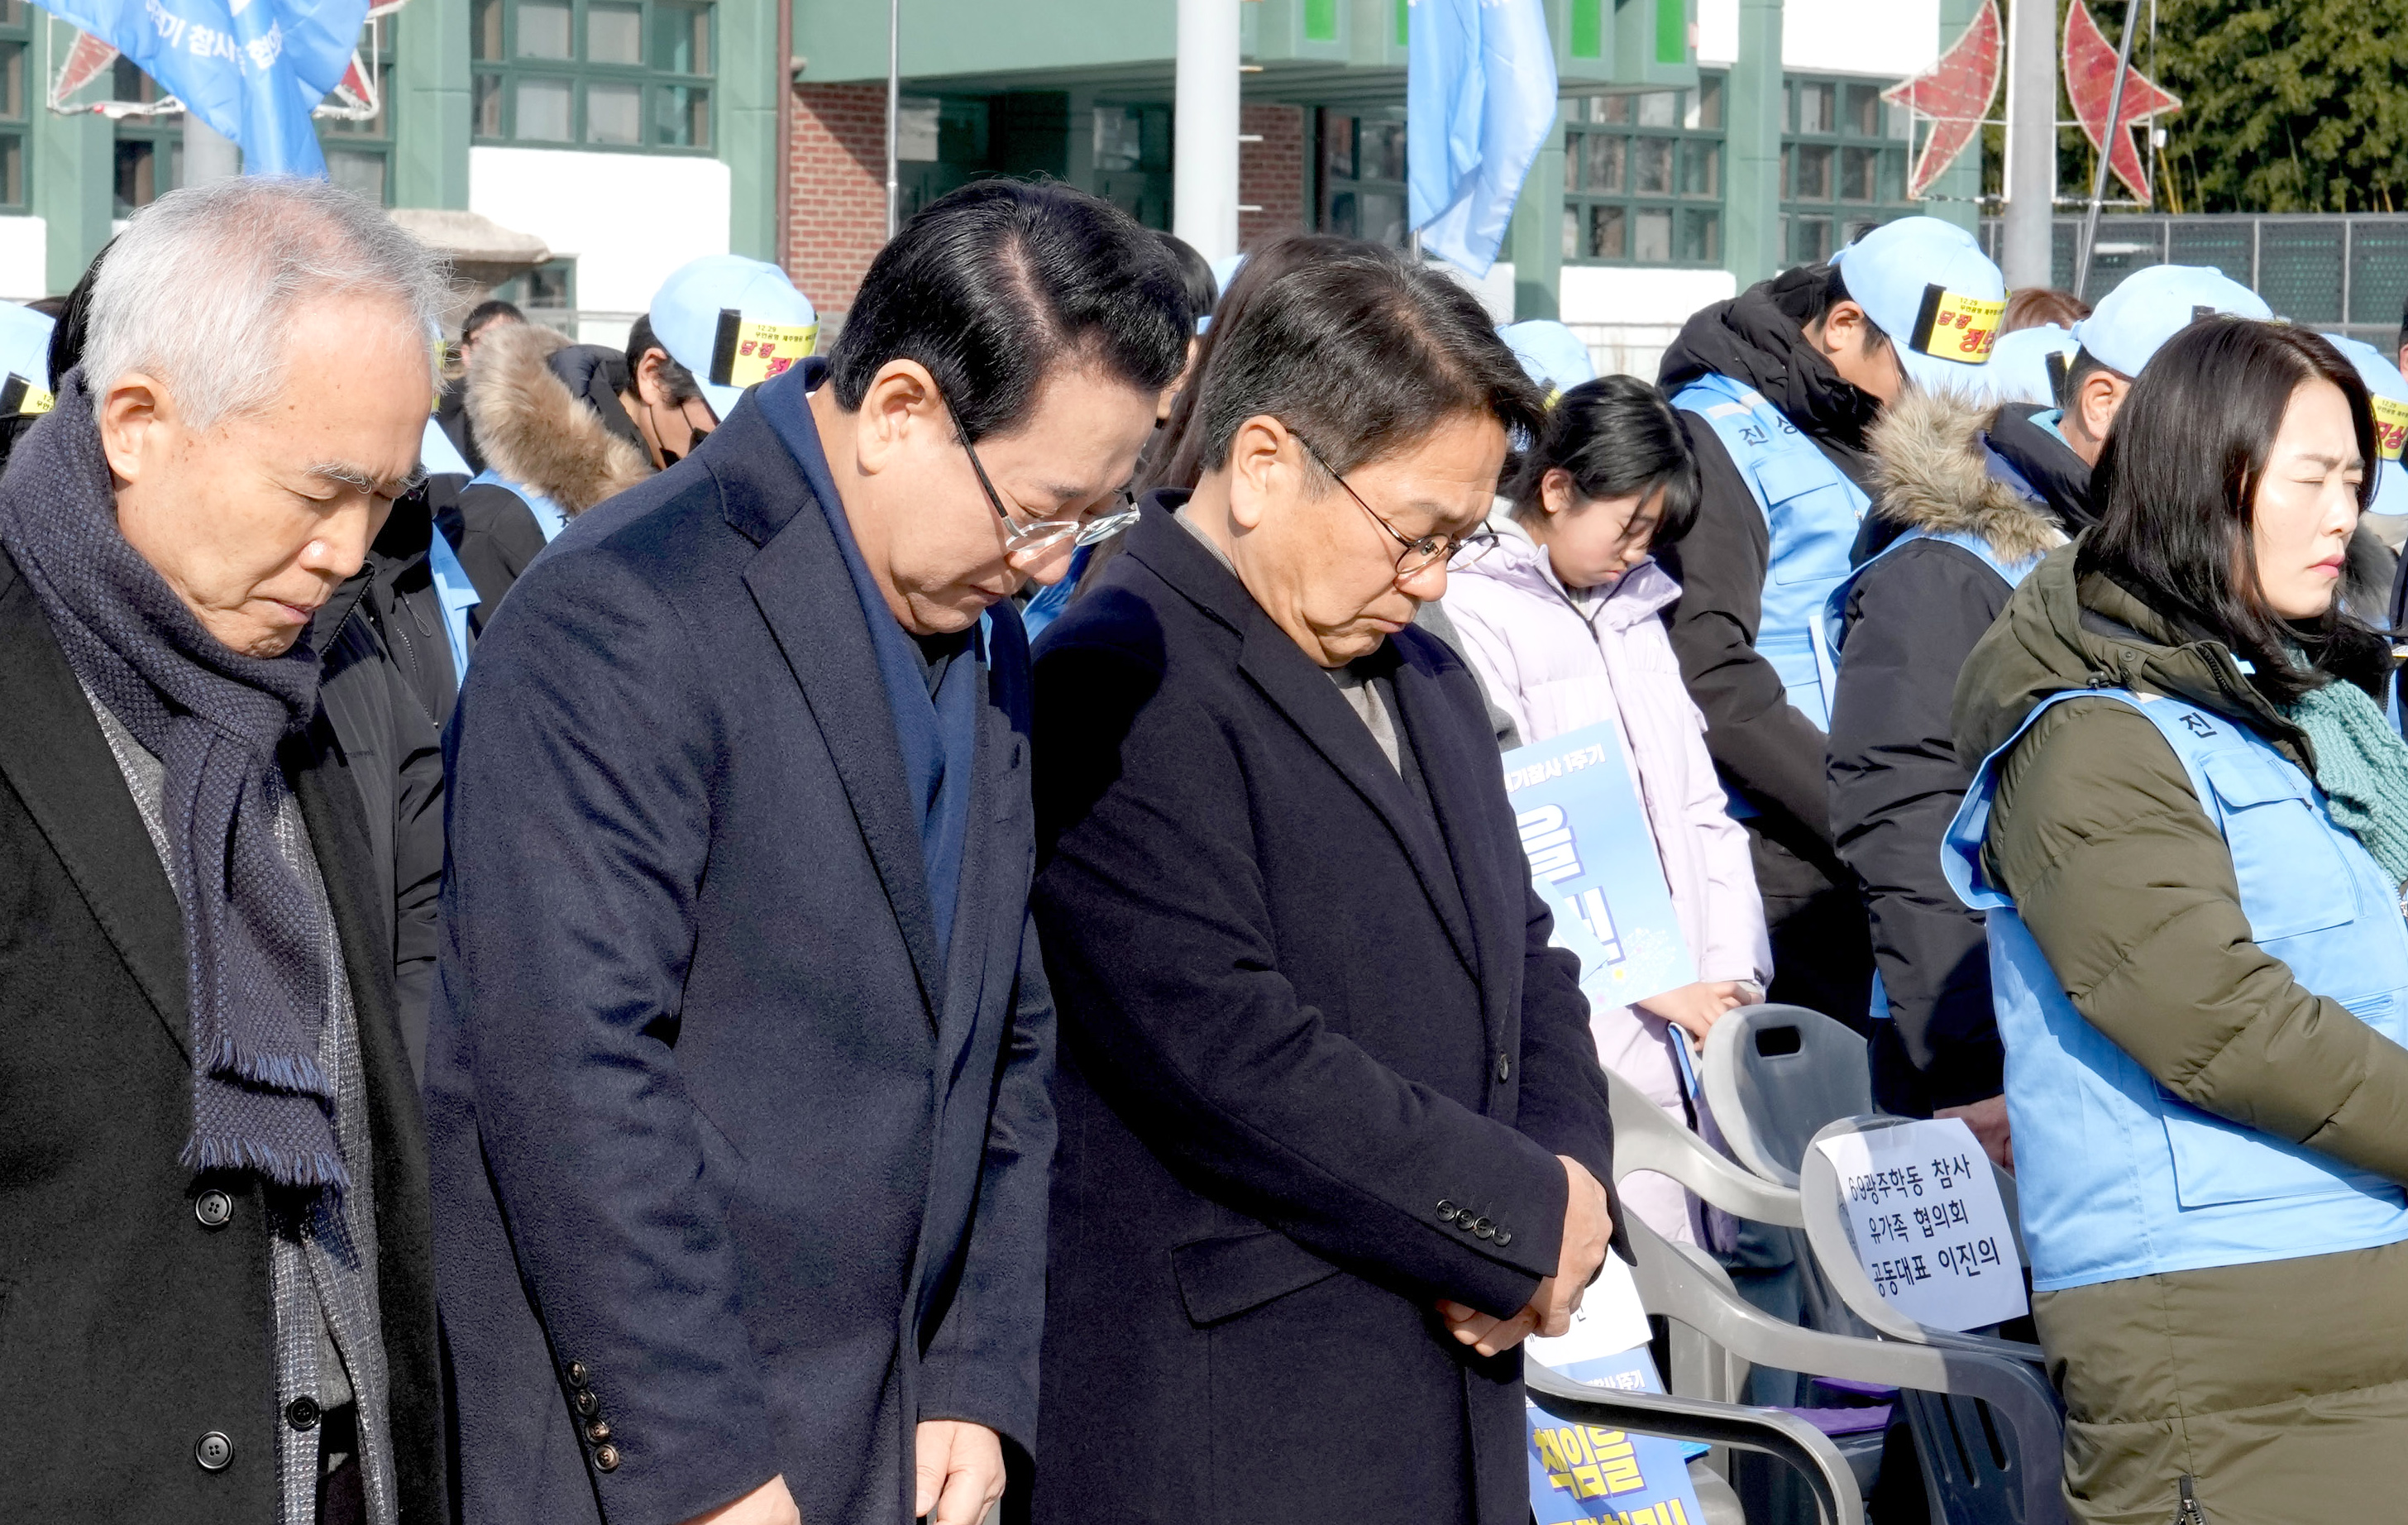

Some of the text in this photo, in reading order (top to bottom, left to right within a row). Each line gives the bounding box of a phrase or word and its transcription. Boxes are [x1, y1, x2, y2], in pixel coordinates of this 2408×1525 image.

[1960, 297, 1978, 306] 12.29
[757, 324, 777, 332] 12.29
[2179, 712, 2217, 739] 진
[1563, 743, 1607, 773] 1주기
[1931, 1154, 1972, 1189] 참사
[1869, 1199, 1969, 1245] 유가족 협의회
[1871, 1236, 2001, 1298] 공동대표 이진의
[1533, 1424, 1647, 1502] 책임을
